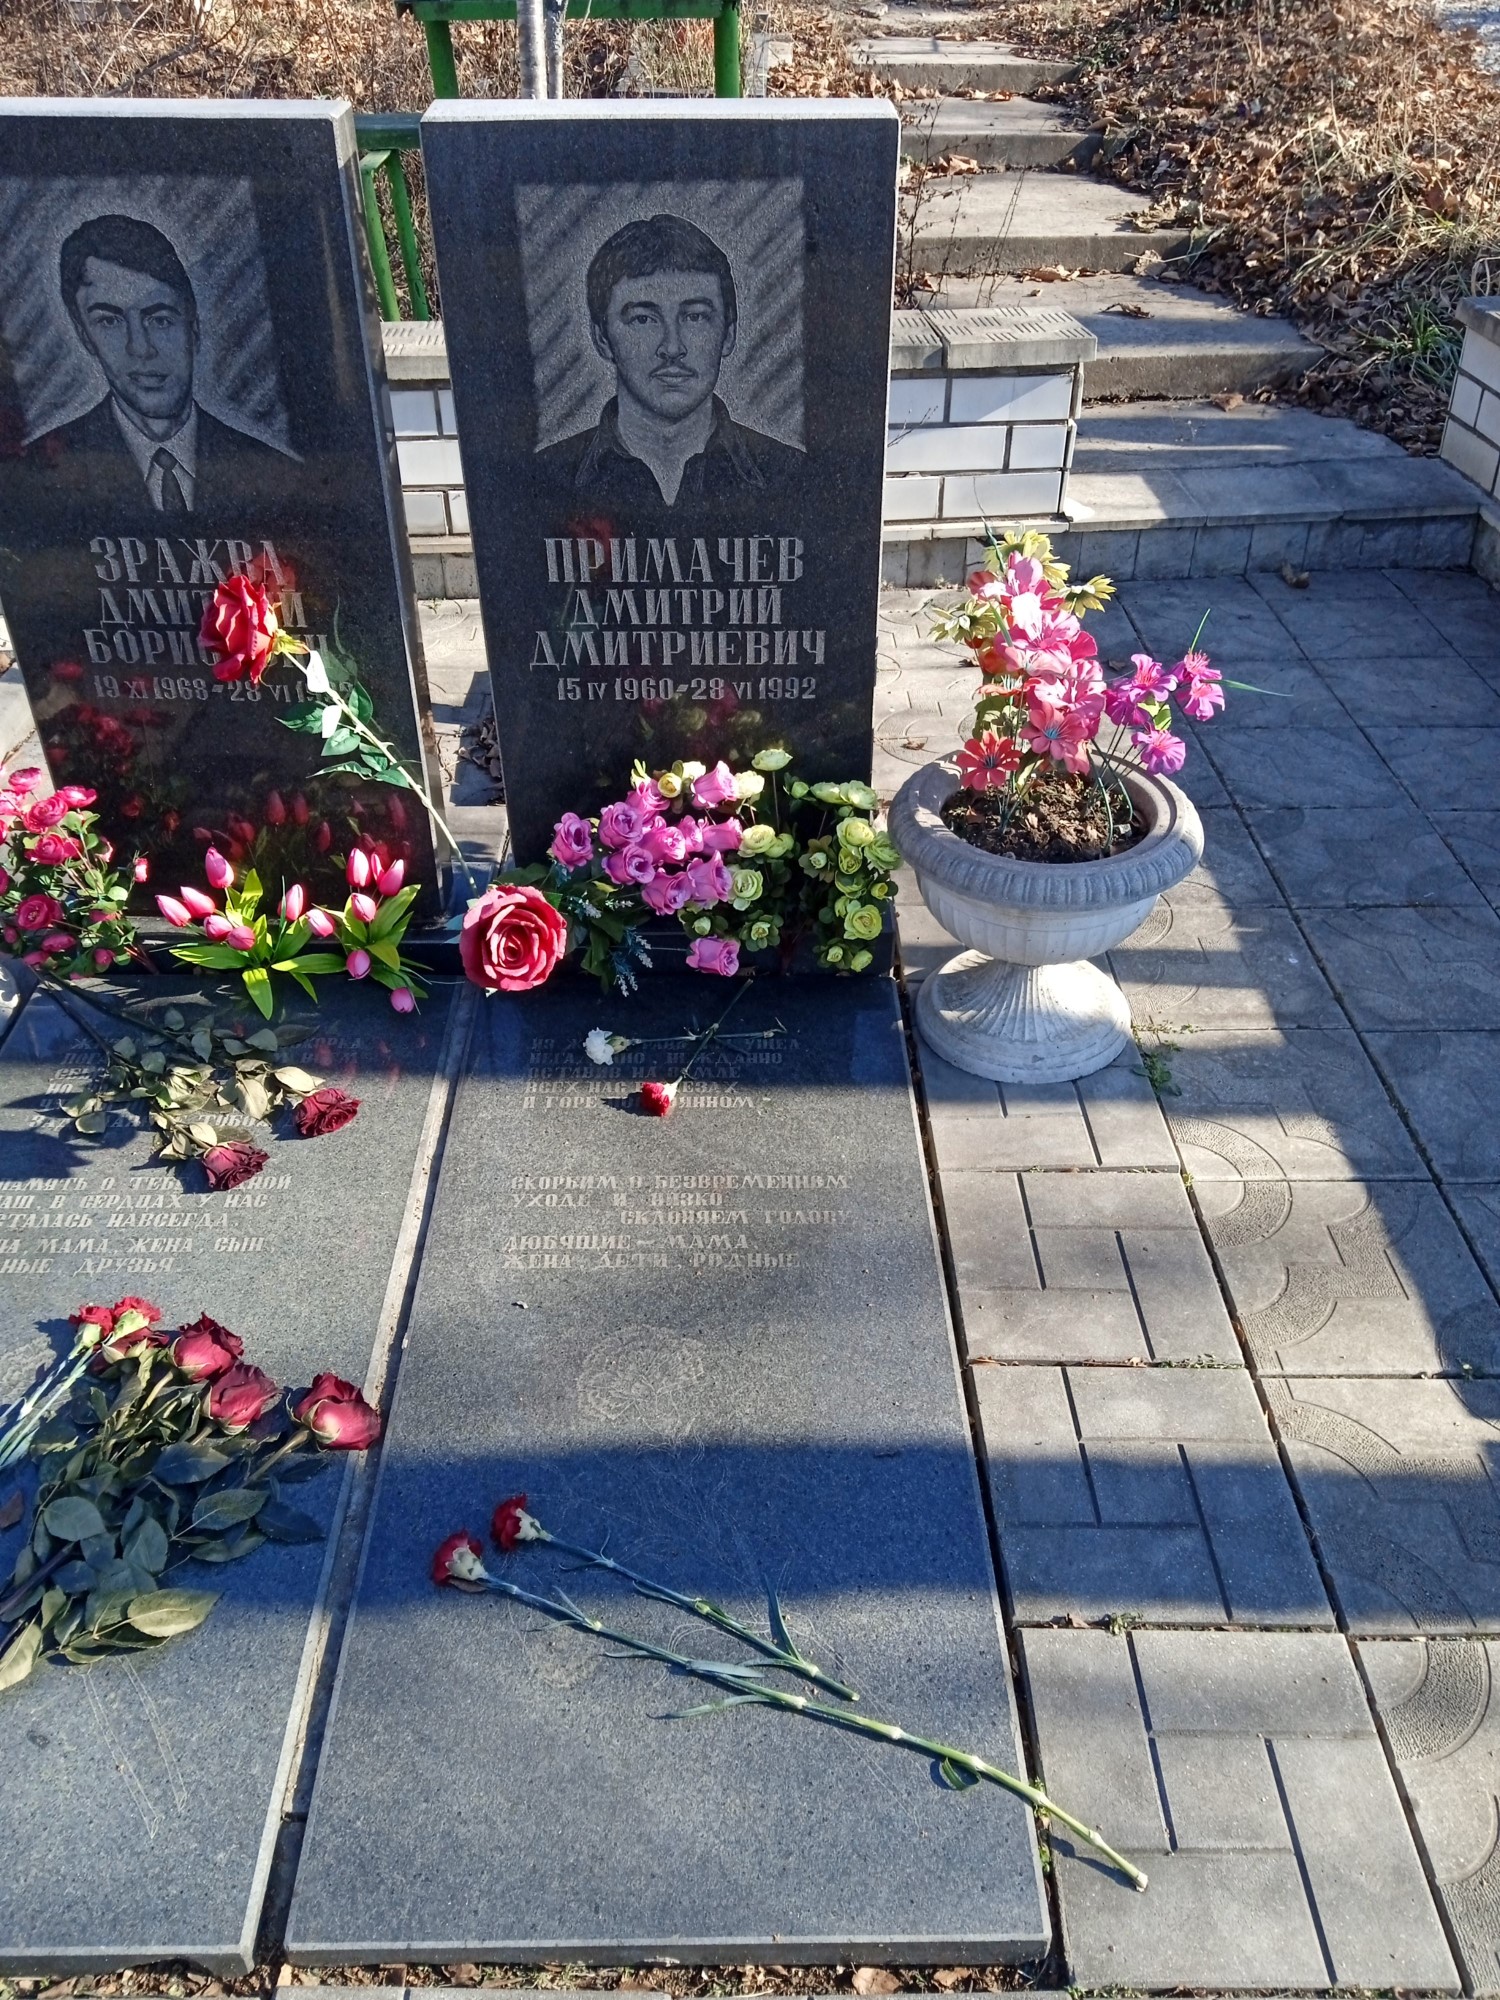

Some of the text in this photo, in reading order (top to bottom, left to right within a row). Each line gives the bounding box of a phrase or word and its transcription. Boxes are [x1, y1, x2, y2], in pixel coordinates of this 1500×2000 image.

[90, 536, 286, 586] ЗРАЖВА
[544, 534, 805, 584] ПРИМАЧЁВ
[98, 588, 308, 630] ДМИТЙ
[570, 584, 784, 630] ДМИТРИЙ
[83, 628, 331, 669] БОРИИЧ
[529, 629, 828, 672] ДМИТРИЕВИЧ
[93, 674, 121, 699] 19
[557, 677, 582, 701] 15
[758, 676, 818, 700] 1992
[632, 1065, 657, 1079] НА
[668, 1065, 741, 1080] ЗМЛЕ
[524, 1080, 580, 1094] ВСЕХ
[589, 1080, 628, 1094] НАС
[682, 1080, 739, 1094] ЕЗАХ
[545, 1095, 599, 1110] ГОРЕ
[101, 1176, 116, 1192] О
[511, 1175, 619, 1190] СКОРБИМ
[628, 1175, 643, 1189] О
[0, 1192, 269, 1212] АШ, В СЕРДЦАХ У НАС
[511, 1192, 591, 1208] УХОДЕ
[620, 1209, 749, 1225] СКЛОНЯЕМ
[502, 1234, 632, 1250] ЛЮБЯЩИЕ
